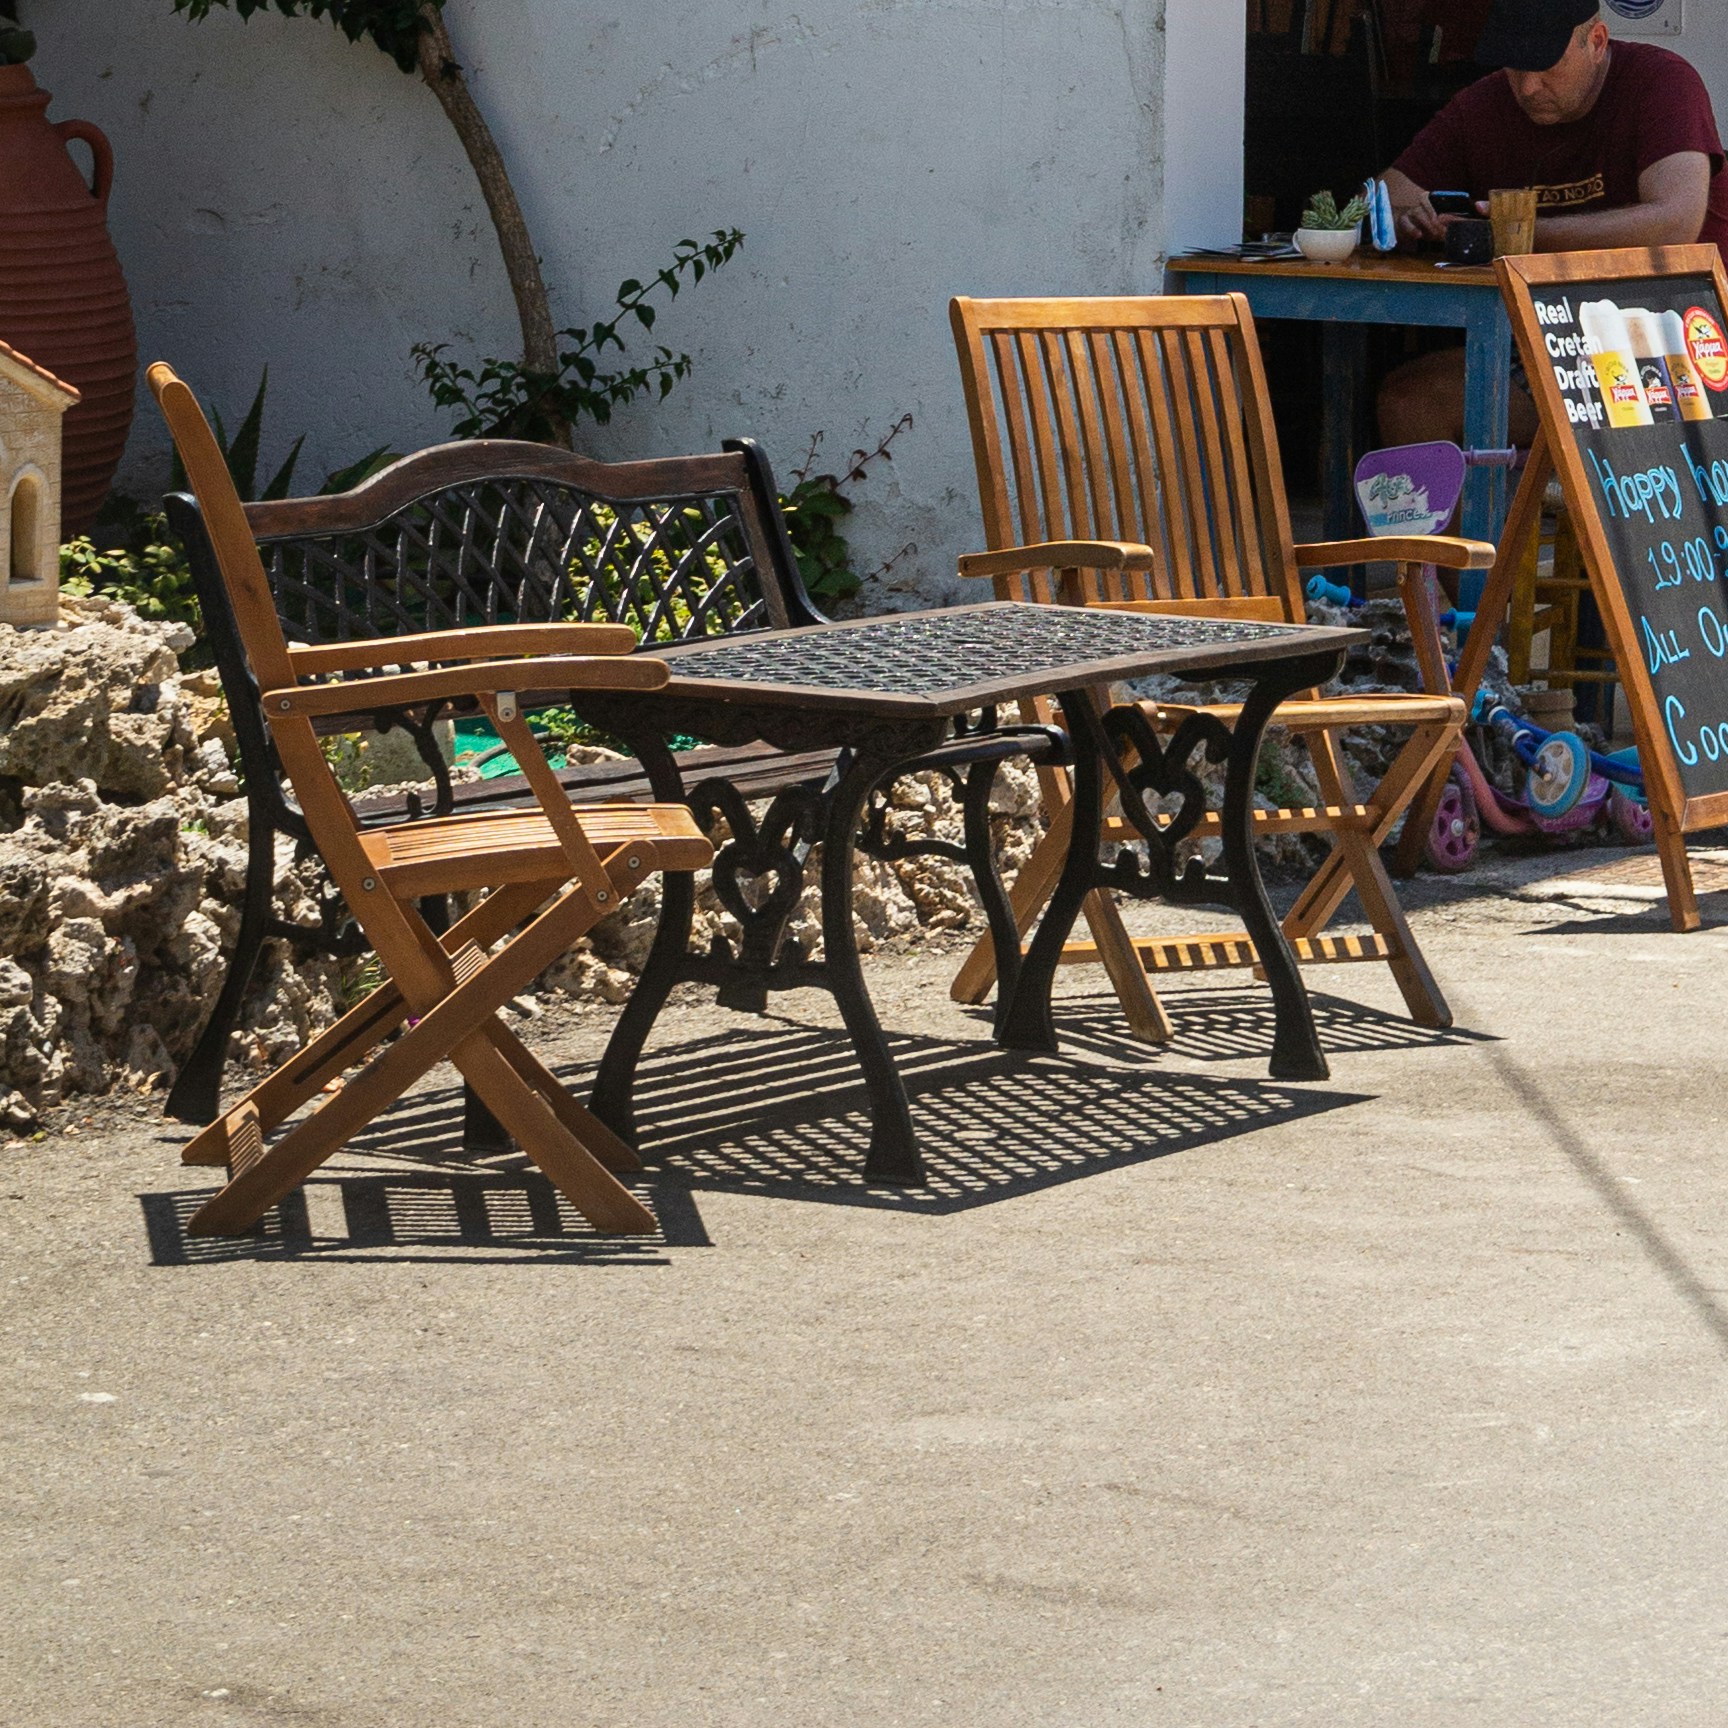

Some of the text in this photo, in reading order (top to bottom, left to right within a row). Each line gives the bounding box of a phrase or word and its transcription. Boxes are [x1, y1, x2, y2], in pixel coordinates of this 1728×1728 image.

[1534, 296, 1574, 326] Real
[1544, 332, 1604, 359] Cretan
[1553, 359, 1601, 391] Draft
[1563, 398, 1603, 424] Beer
[1587, 447, 1681, 523] Happy
